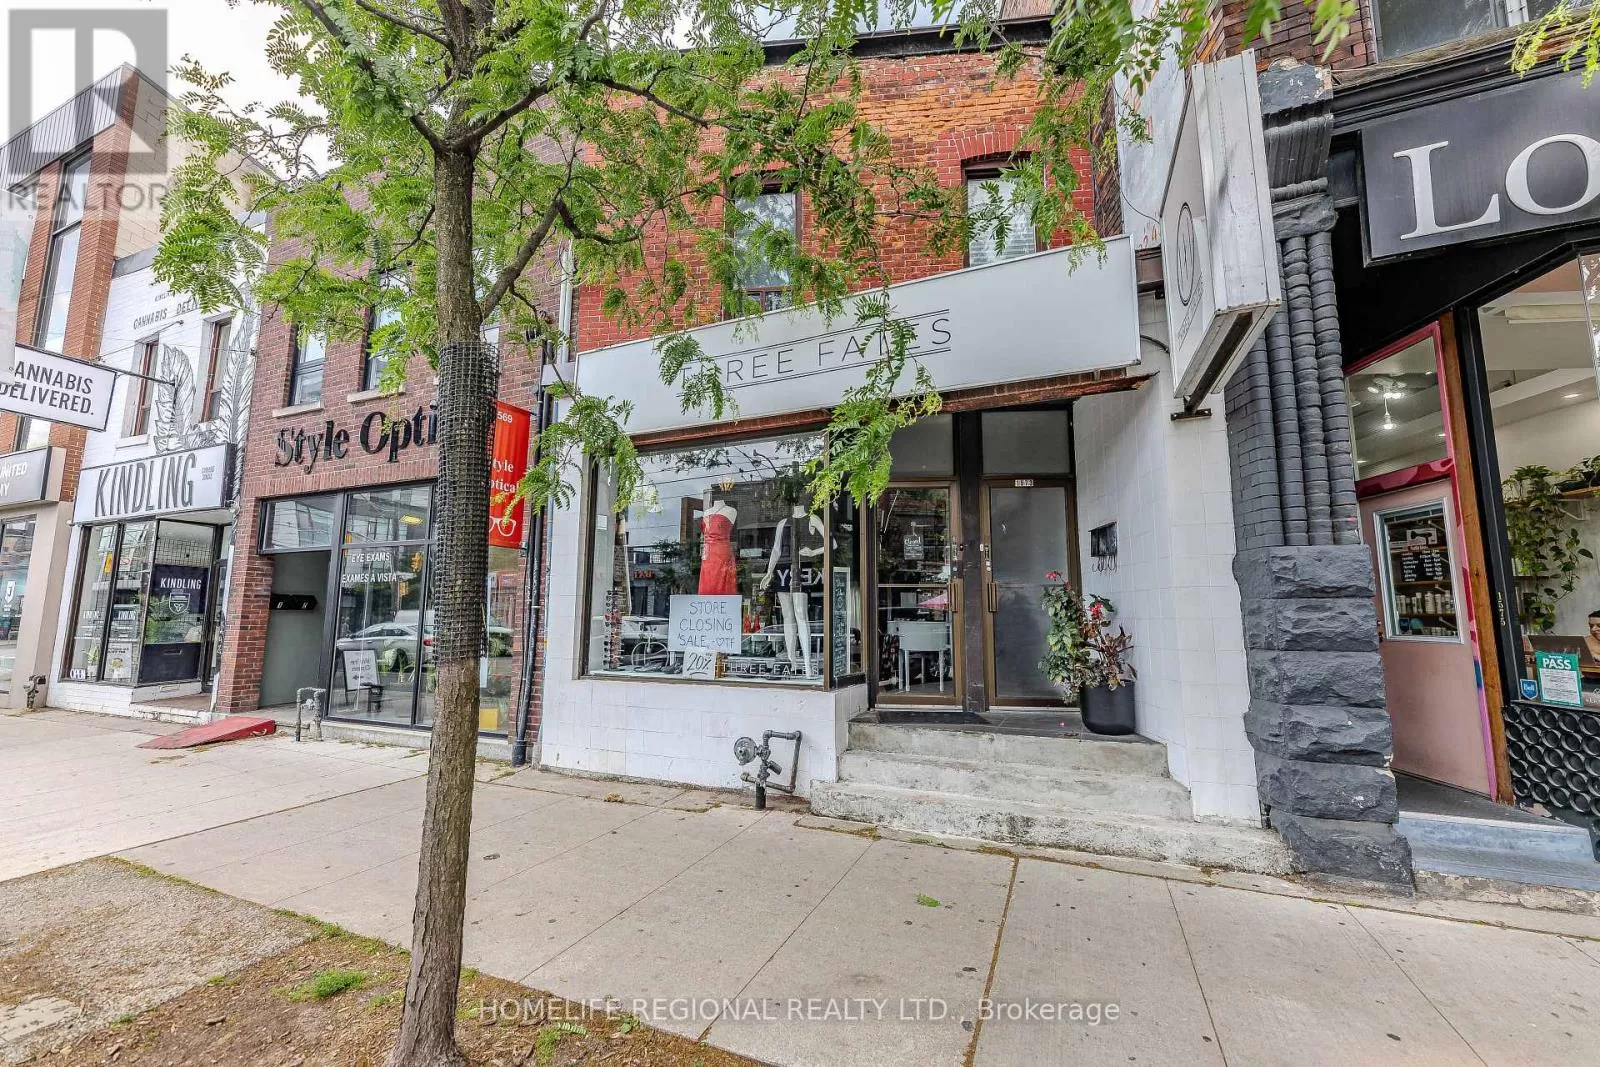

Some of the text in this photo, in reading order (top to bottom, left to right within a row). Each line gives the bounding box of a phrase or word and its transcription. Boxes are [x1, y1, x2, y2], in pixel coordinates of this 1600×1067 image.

[133, 308, 168, 330] CANNABIS
[679, 347, 794, 389] TREE
[15, 360, 94, 394] ANNABIS
[274, 420, 350, 474] Style
[492, 458, 514, 473] tyle
[95, 452, 197, 517] KINDLING
[351, 551, 390, 563] EYE EXAMS
[160, 577, 202, 590] KINDLING
[341, 573, 370, 583] EXAMES
[378, 571, 397, 582] VISTA
[689, 601, 727, 615] STORE
[680, 618, 733, 632] CLOSING
[687, 652, 712, 672] 20%
[722, 663, 766, 674] THREE
[1542, 658, 1572, 670] PASS
[70, 668, 86, 680] OPEN
